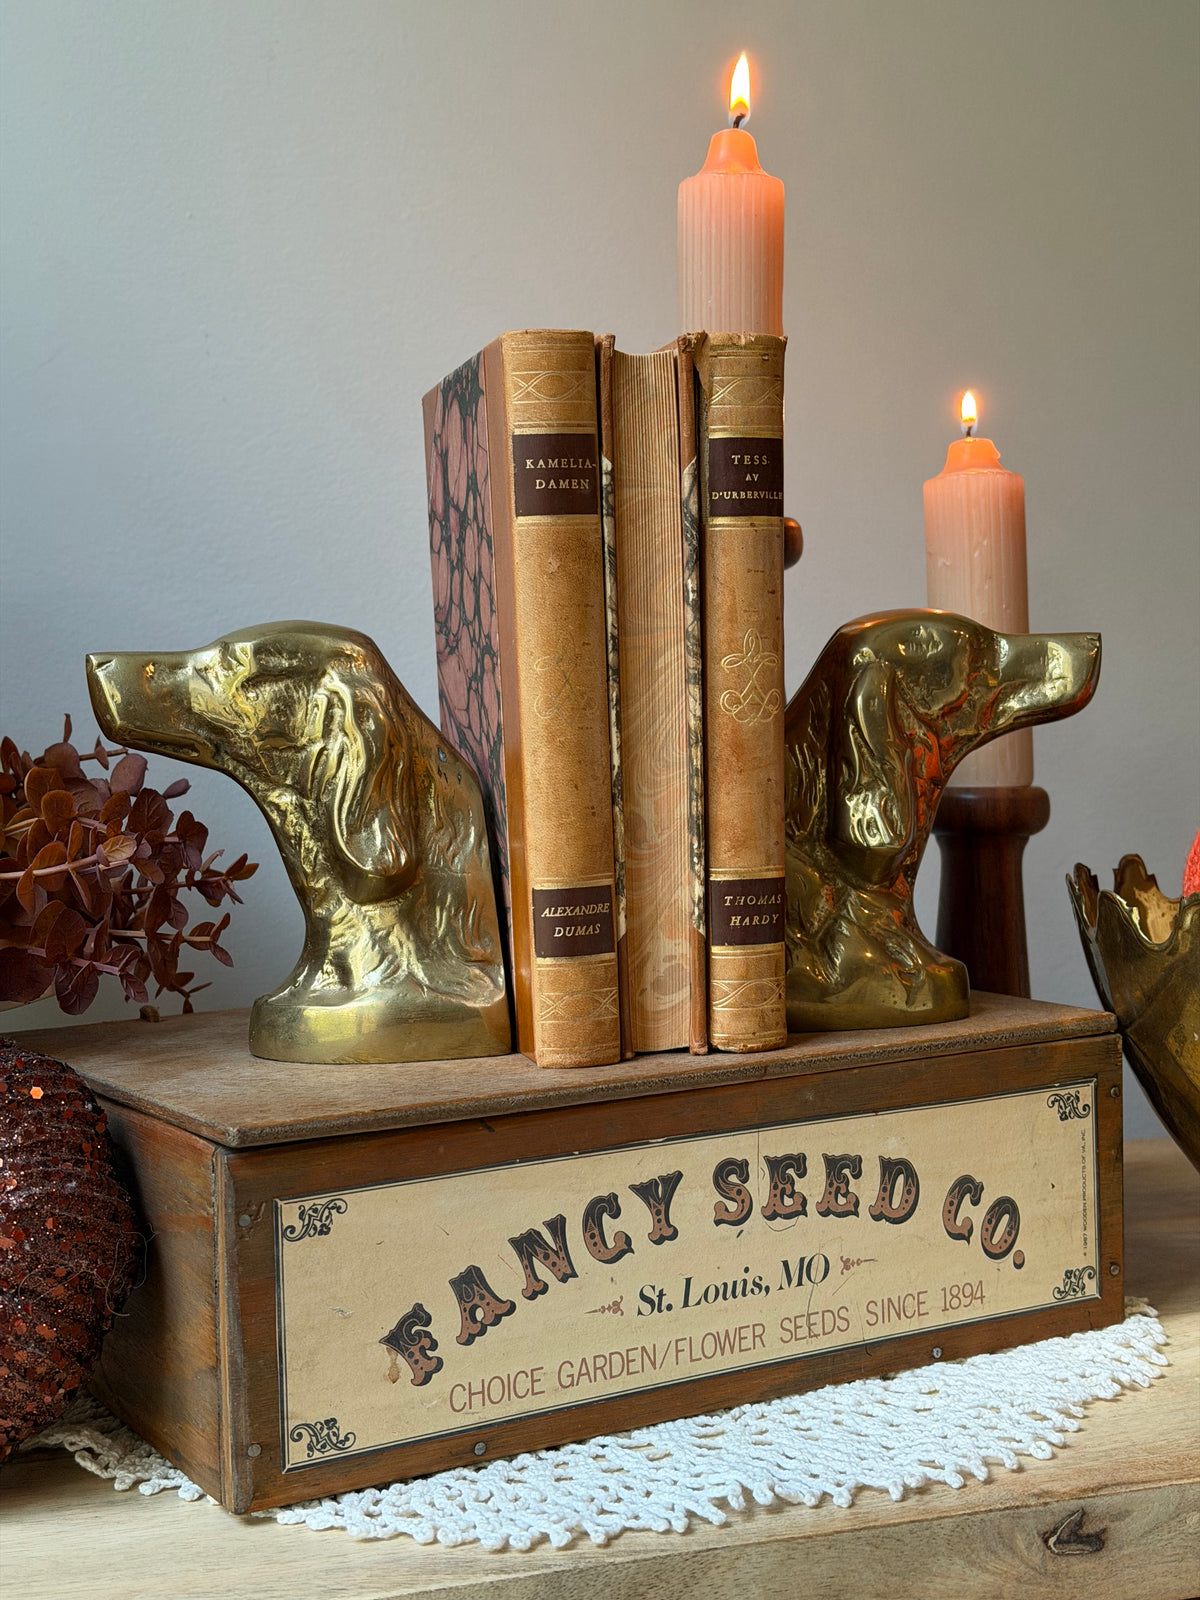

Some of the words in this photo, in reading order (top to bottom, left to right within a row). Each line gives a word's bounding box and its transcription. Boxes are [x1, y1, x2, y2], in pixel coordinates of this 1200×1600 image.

[525, 458, 597, 469] KAMELIA-
[731, 454, 768, 465] TESS
[745, 473, 759, 482] AV
[535, 479, 590, 490] DAMEN
[724, 894, 782, 906] THOMAS
[541, 902, 610, 918] ALEXANDRE
[729, 913, 780, 926] HARDY
[553, 923, 601, 938] DUMAS
[378, 1169, 684, 1387] FANCY
[712, 1152, 920, 1227] SEED
[942, 1174, 1026, 1270] CO.
[636, 1284, 675, 1317] St.
[681, 1266, 771, 1309] Louis,
[776, 1252, 831, 1290] MO
[449, 1366, 546, 1413] CHOICE
[557, 1322, 766, 1390] GARDEN/FLOWER
[779, 1306, 851, 1344] SEEDS
[865, 1290, 930, 1327] SINCE
[940, 1280, 986, 1313] 1894
